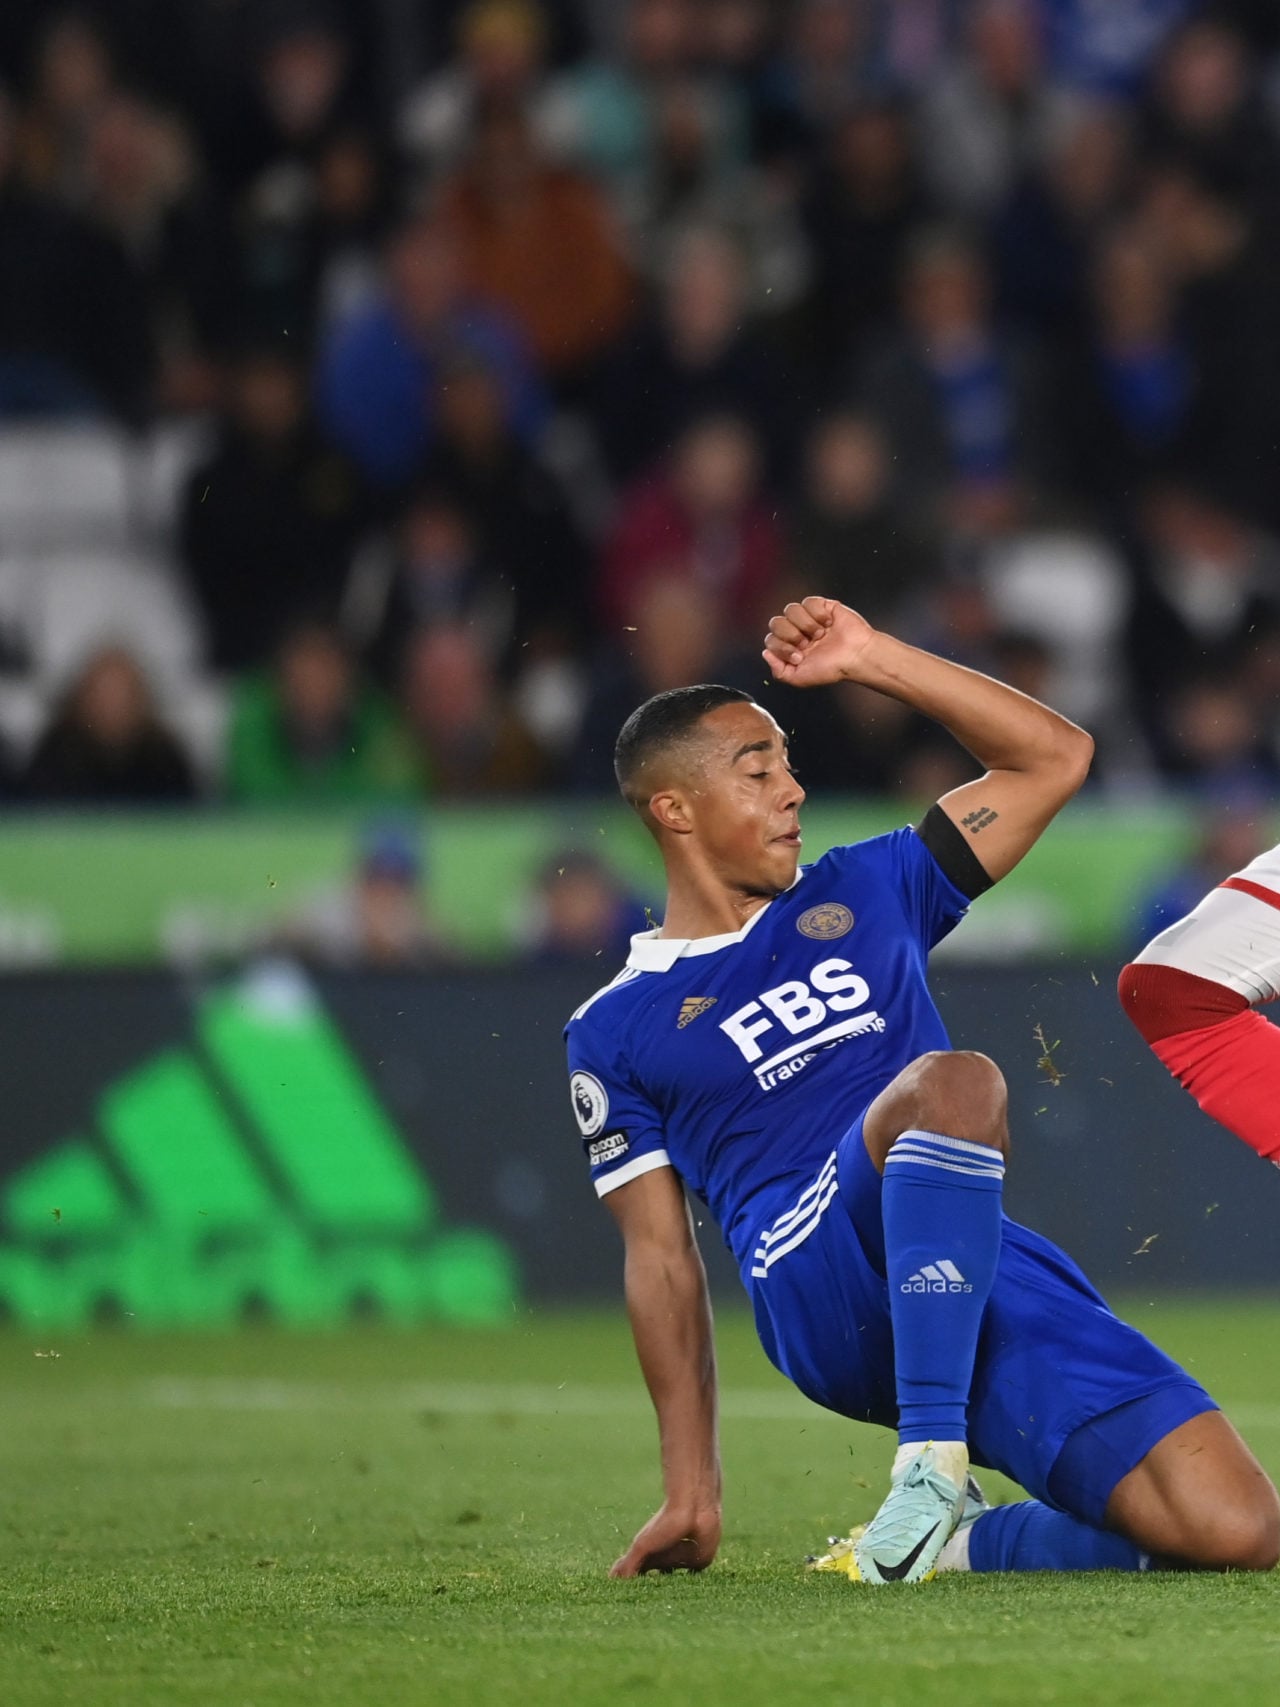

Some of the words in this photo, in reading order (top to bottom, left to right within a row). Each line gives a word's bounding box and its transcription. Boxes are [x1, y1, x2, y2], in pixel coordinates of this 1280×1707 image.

[676, 997, 718, 1029] adidas
[719, 958, 870, 1063] FBS
[900, 1278, 973, 1294] adidas
